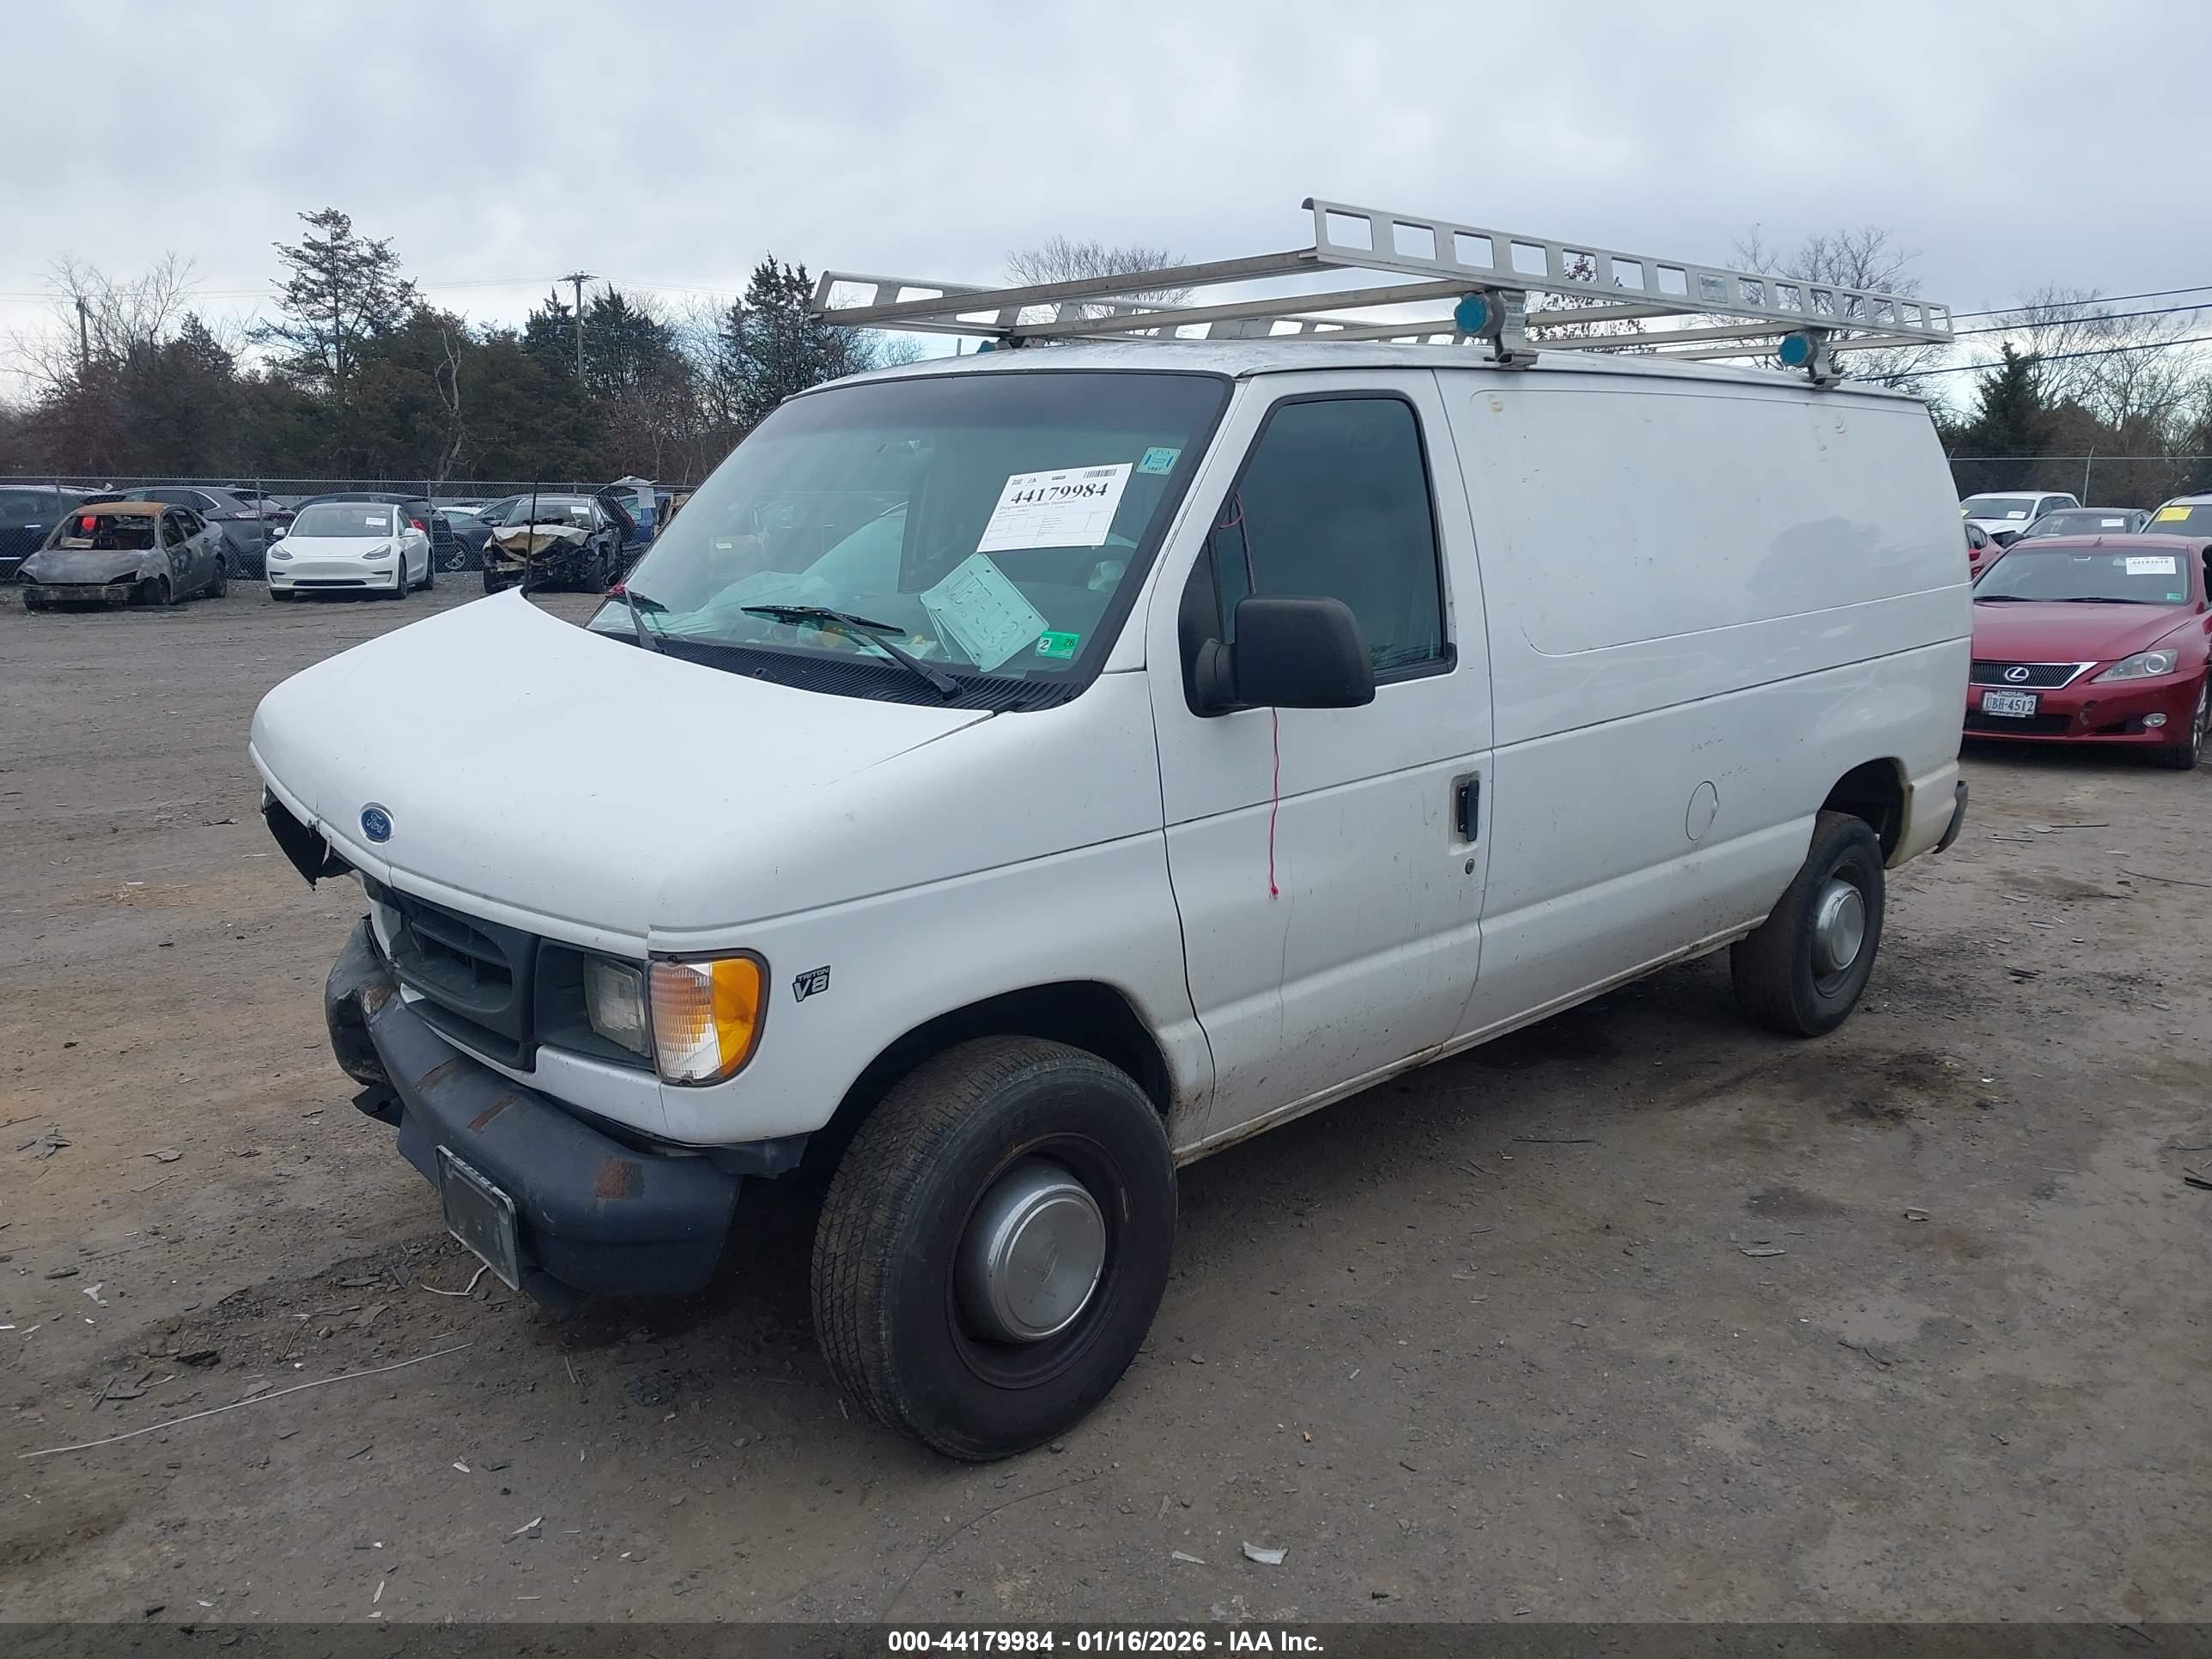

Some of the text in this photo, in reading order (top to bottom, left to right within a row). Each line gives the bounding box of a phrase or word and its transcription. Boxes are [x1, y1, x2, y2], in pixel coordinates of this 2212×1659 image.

[1011, 482, 1109, 503] 44179984
[1040, 638, 1076, 650] 2 26
[1985, 697, 2034, 712] UBH-4512
[366, 812, 386, 834] Ford
[797, 967, 830, 981] TRITON
[793, 975, 827, 1001] V8
